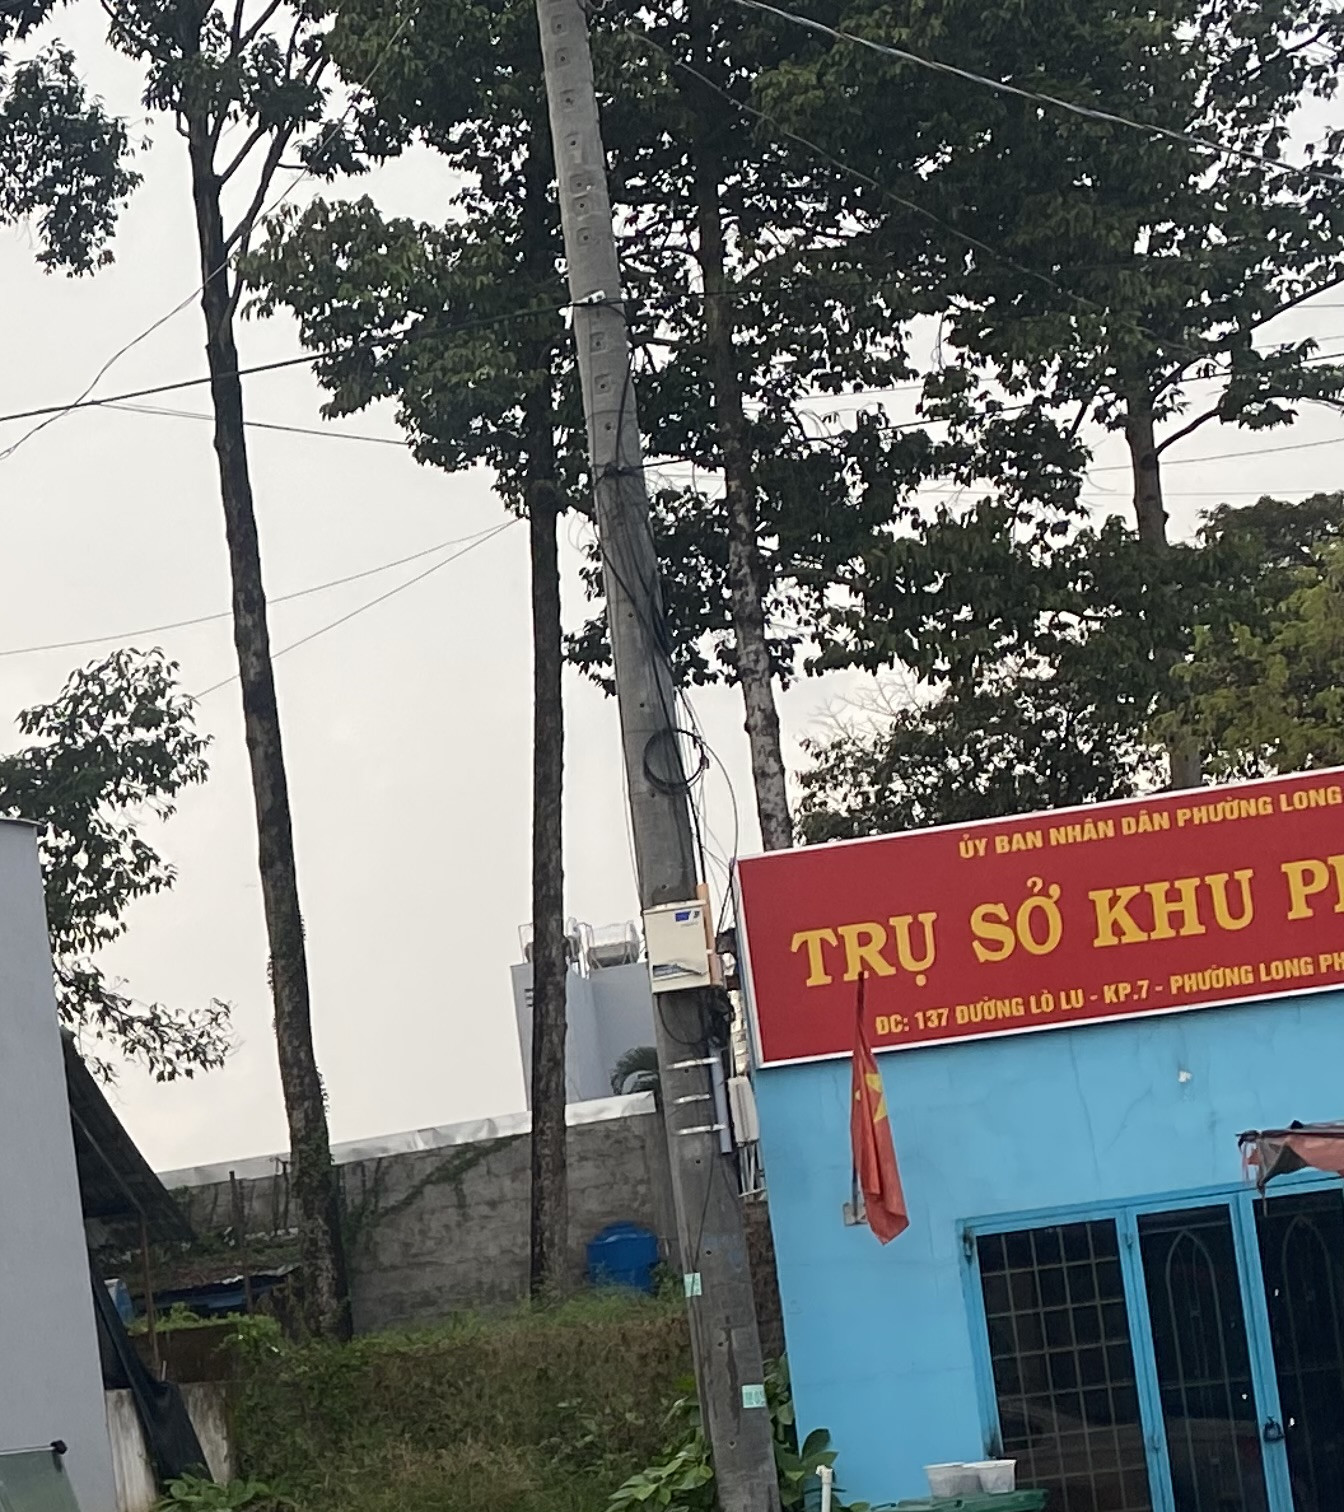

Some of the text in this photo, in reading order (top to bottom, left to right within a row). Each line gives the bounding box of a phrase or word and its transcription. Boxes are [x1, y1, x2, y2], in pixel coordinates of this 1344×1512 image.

[958, 786, 1343, 860] ỦY BAN NHÂN DÂN PHƯỜNG LONG
[791, 913, 939, 987] TRỤ
[970, 876, 1064, 964] SỞ
[1089, 868, 1254, 948] KHU
[875, 1014, 911, 1036] ĐC:
[914, 1008, 950, 1030] 137
[955, 992, 1025, 1025] ĐƯỜNG
[1029, 988, 1055, 1016] LÒ
[1060, 988, 1084, 1011] LU
[1103, 981, 1150, 1006] KP.7
[1170, 961, 1254, 996] PHƯỜNG
[1259, 956, 1314, 984] LONG
